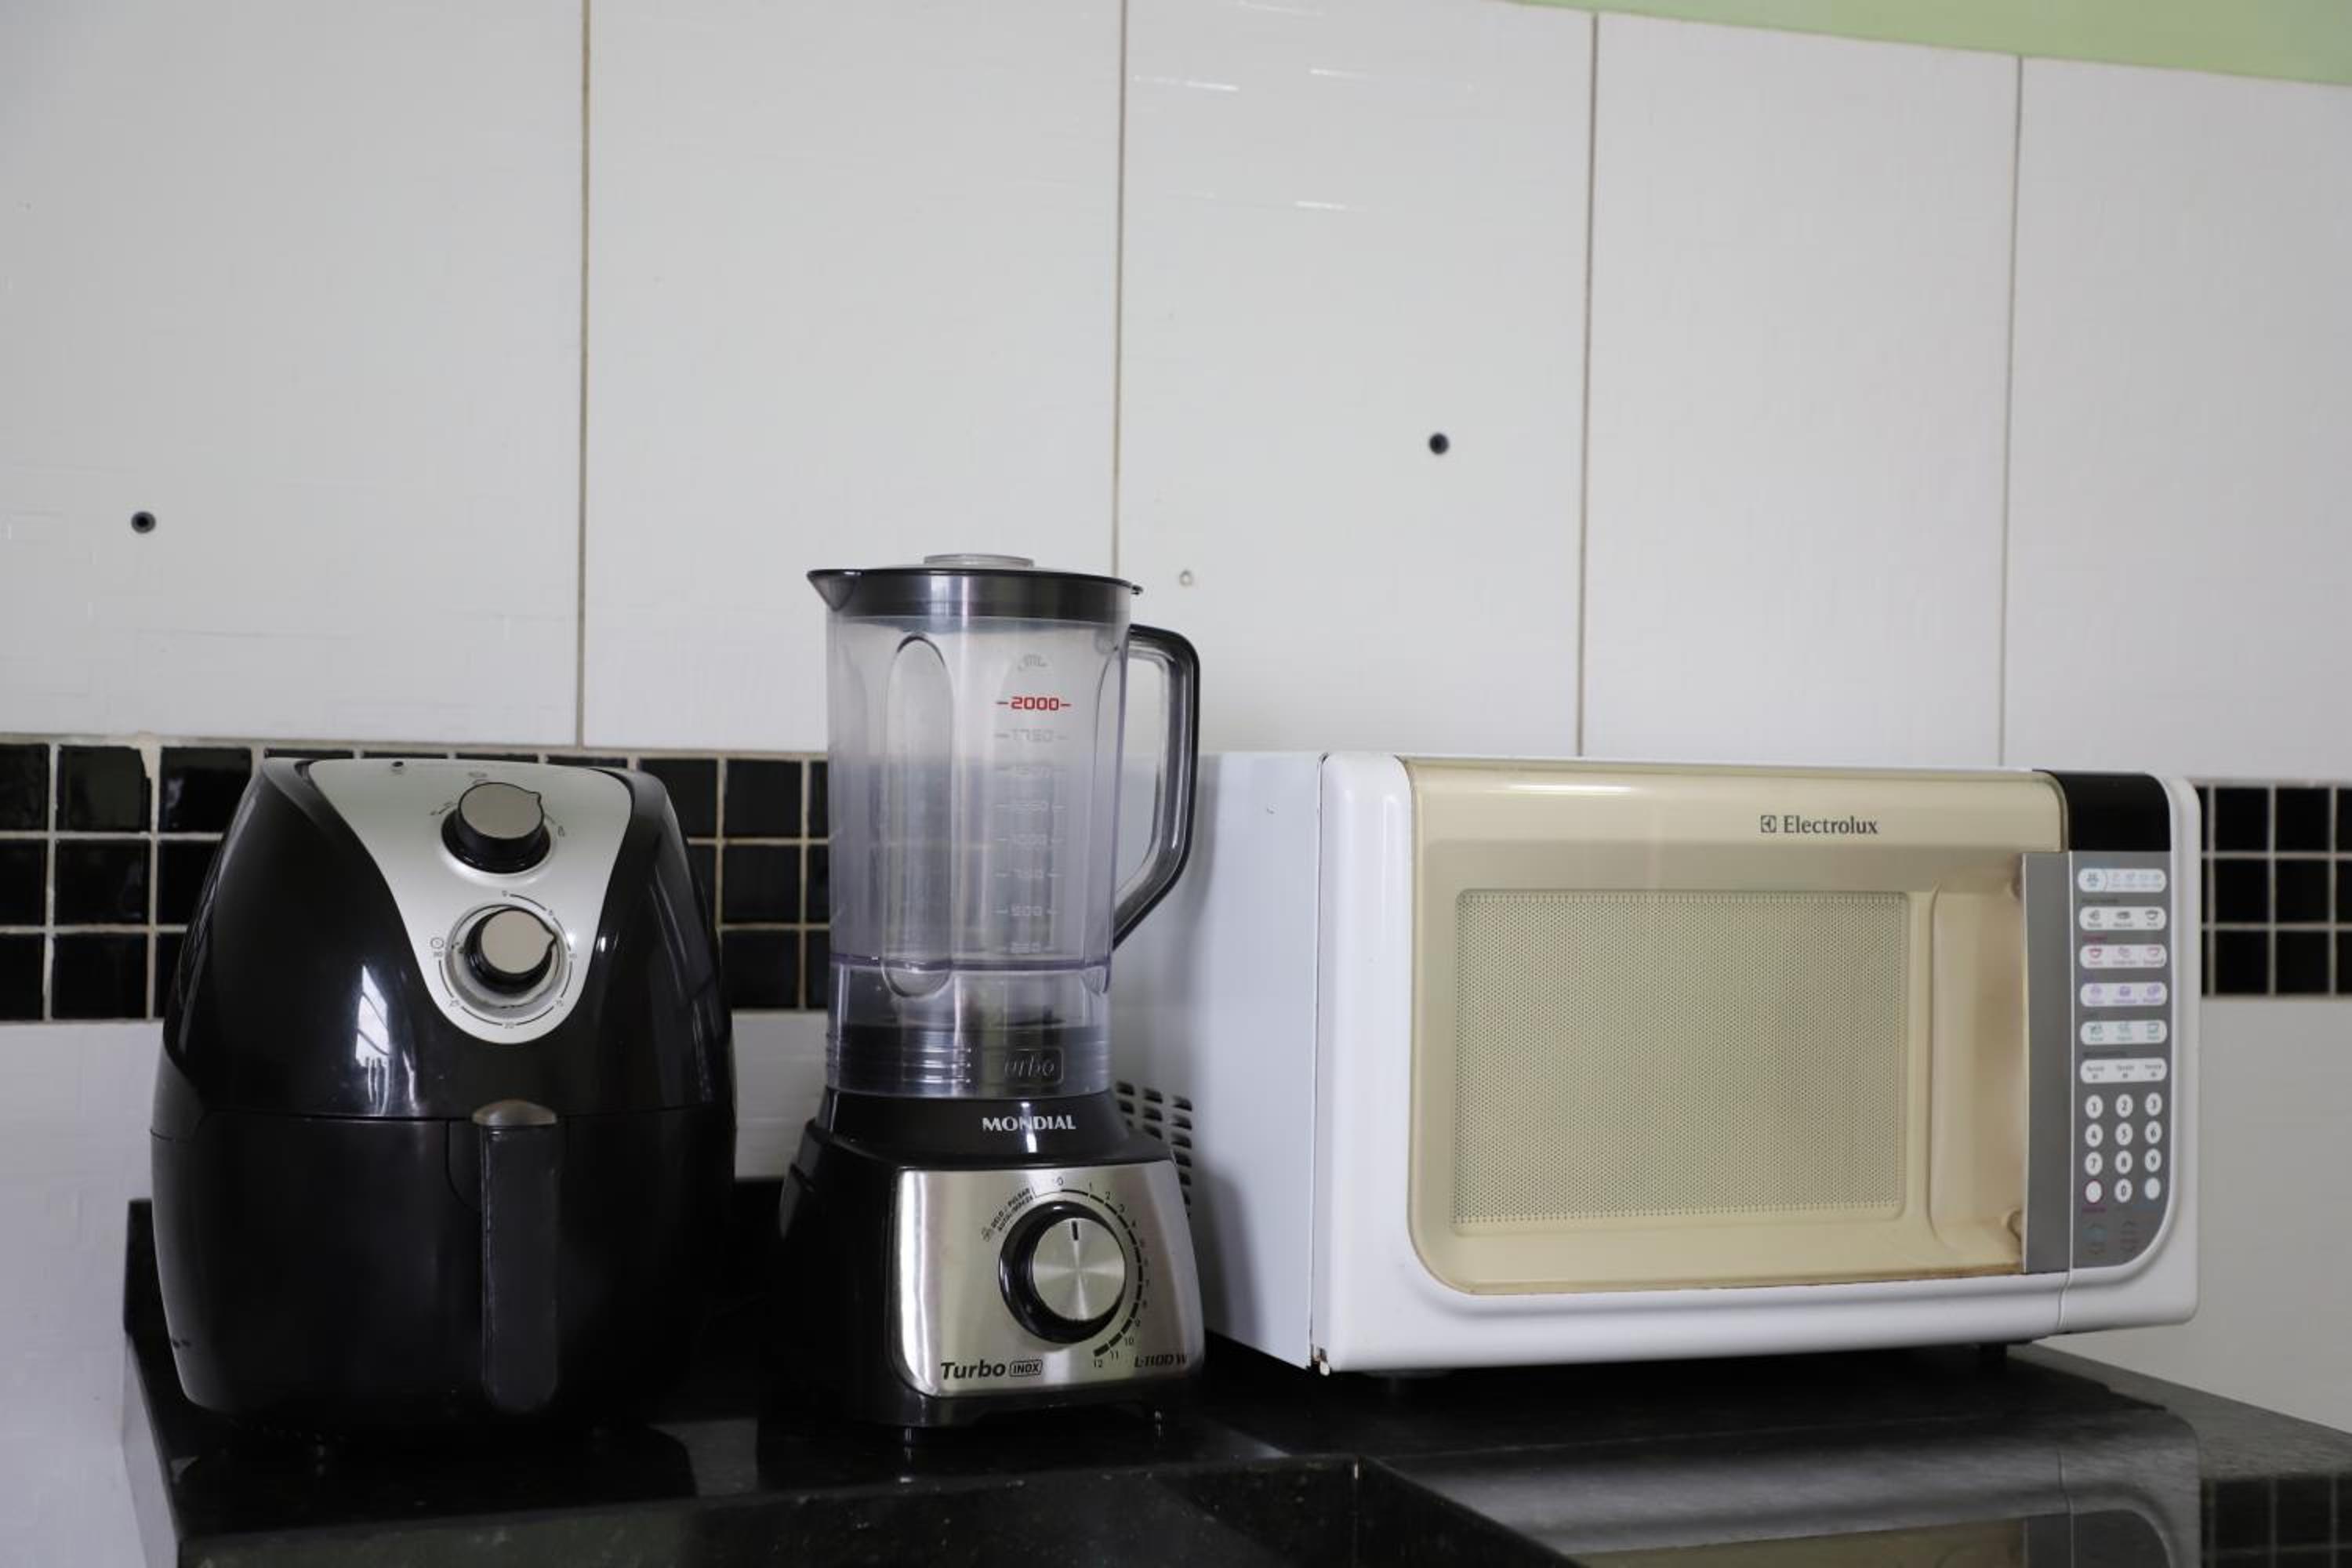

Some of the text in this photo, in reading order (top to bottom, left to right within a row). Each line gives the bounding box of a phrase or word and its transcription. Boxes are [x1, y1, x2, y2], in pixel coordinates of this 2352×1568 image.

[1011, 696, 1059, 710] 2000
[1784, 815, 1878, 833] Electrolux
[982, 1114, 1076, 1131] MONDIAL
[1123, 1336, 1134, 1346] 10
[1109, 1350, 1120, 1362] 11
[940, 1358, 1040, 1380] Turbo INOX
[1094, 1358, 1103, 1369] 12
